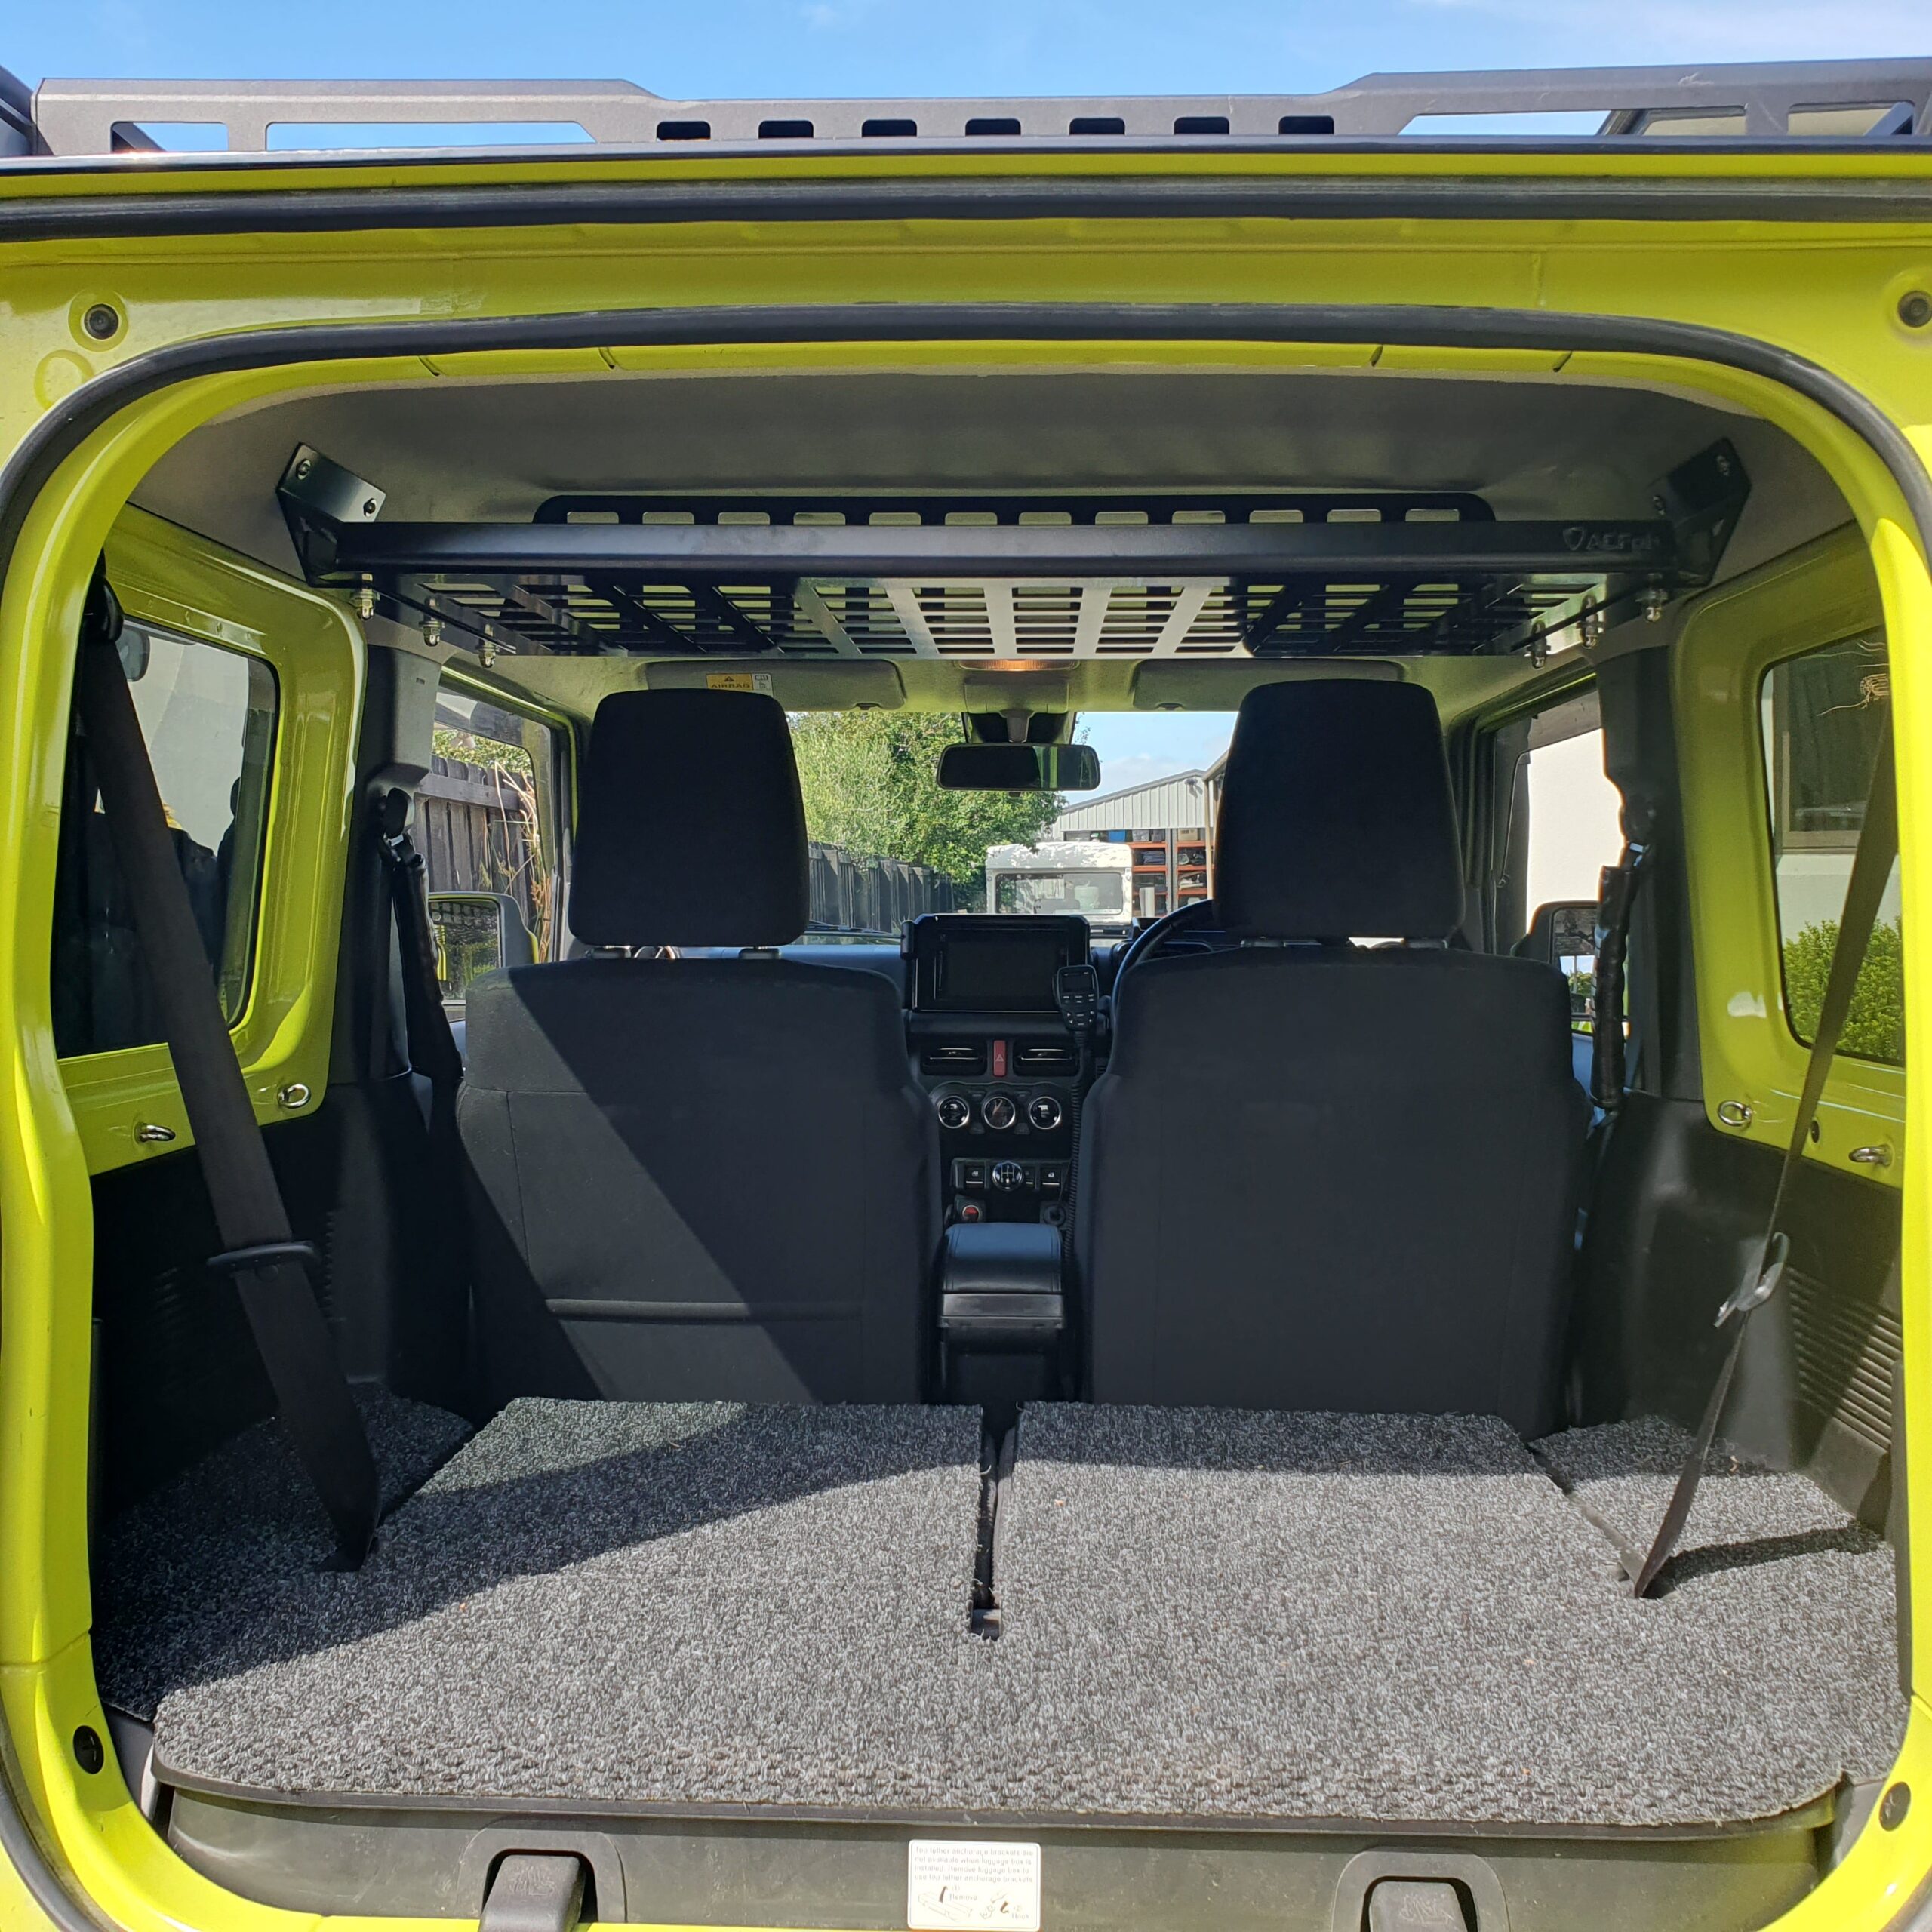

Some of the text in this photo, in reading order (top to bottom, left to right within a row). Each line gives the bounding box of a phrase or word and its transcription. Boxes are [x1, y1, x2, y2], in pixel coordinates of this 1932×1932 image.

[951, 1847, 989, 1856] anchorage
[981, 1857, 1009, 1866] luggage
[978, 1866, 1006, 1875] luggage
[964, 1875, 1001, 1883] anchorage
